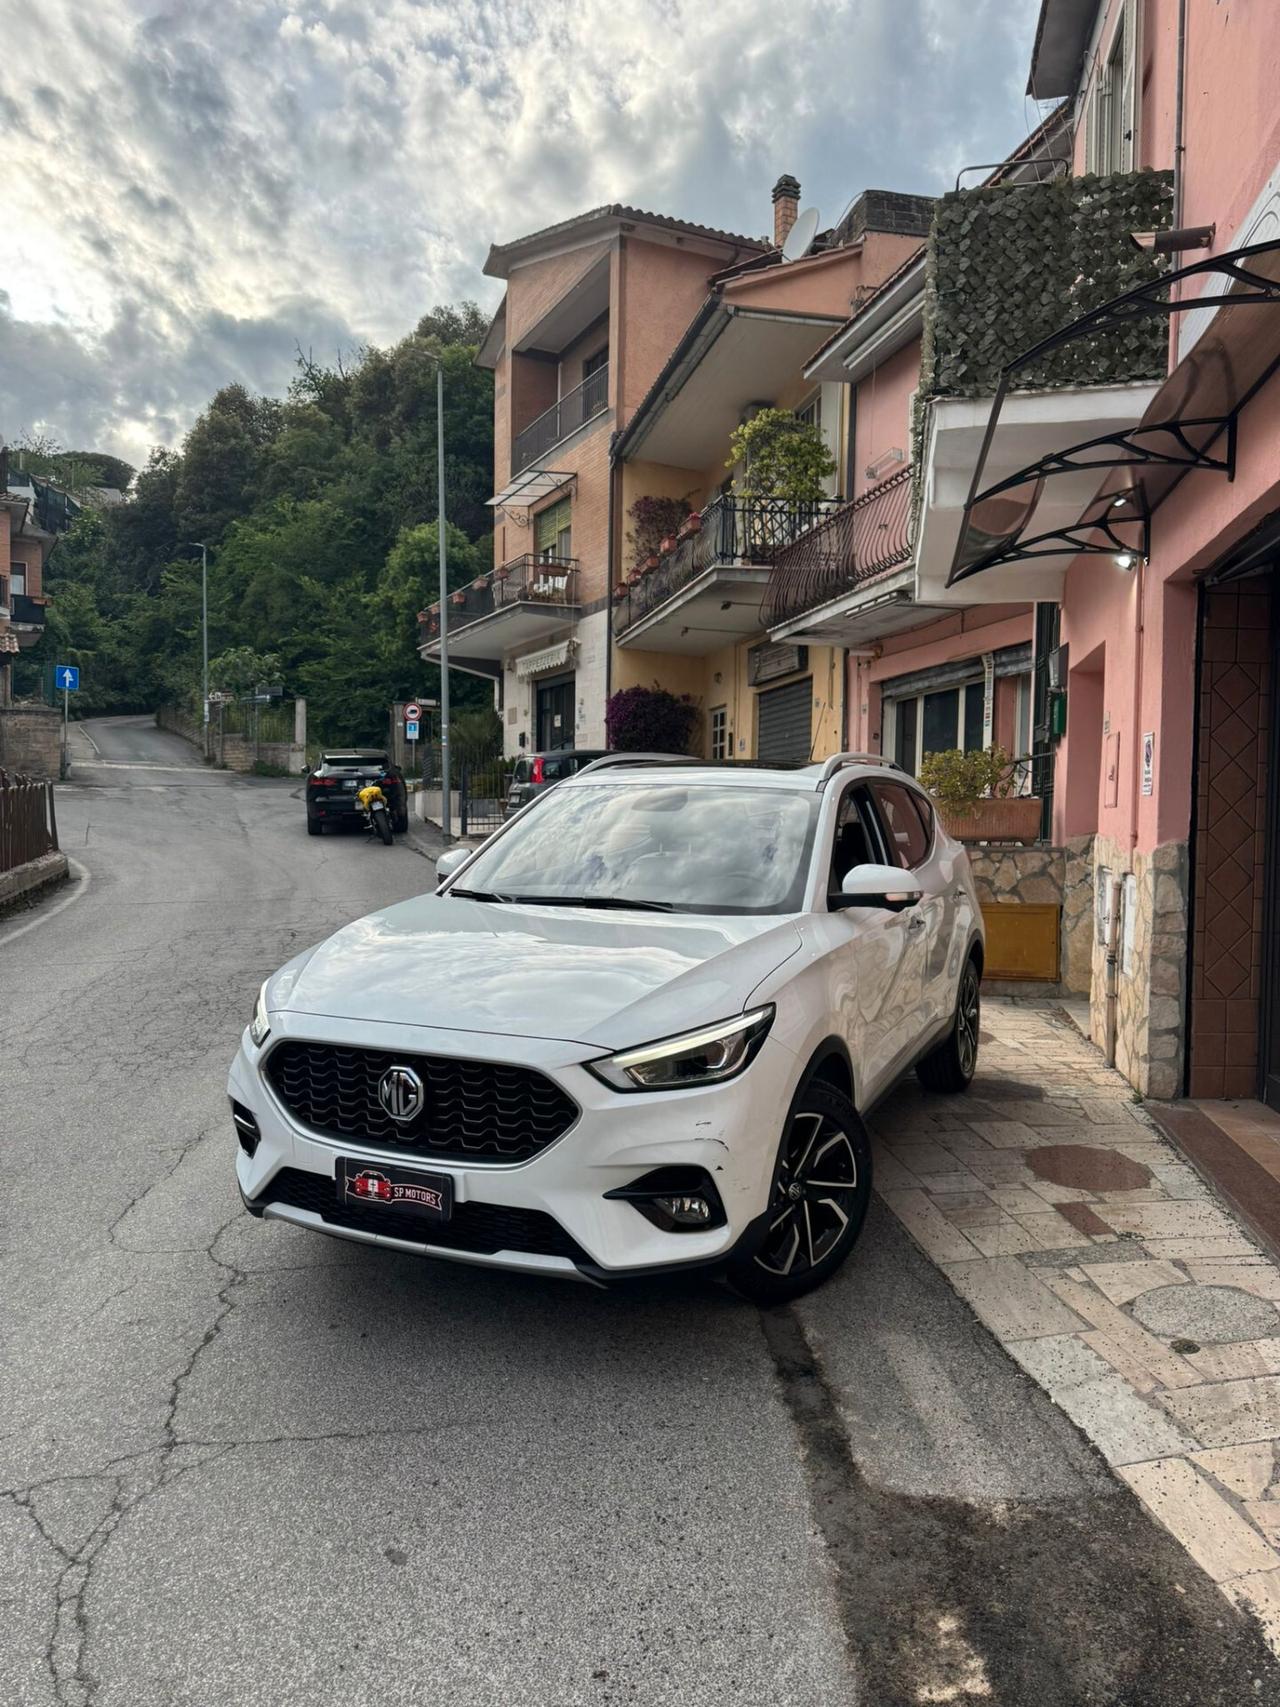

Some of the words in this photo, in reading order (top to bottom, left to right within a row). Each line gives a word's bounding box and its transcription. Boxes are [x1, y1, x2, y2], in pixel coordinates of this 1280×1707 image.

[382, 1071, 418, 1116] MG
[395, 1187, 404, 1197] SP
[405, 1189, 436, 1205] MOTORS
